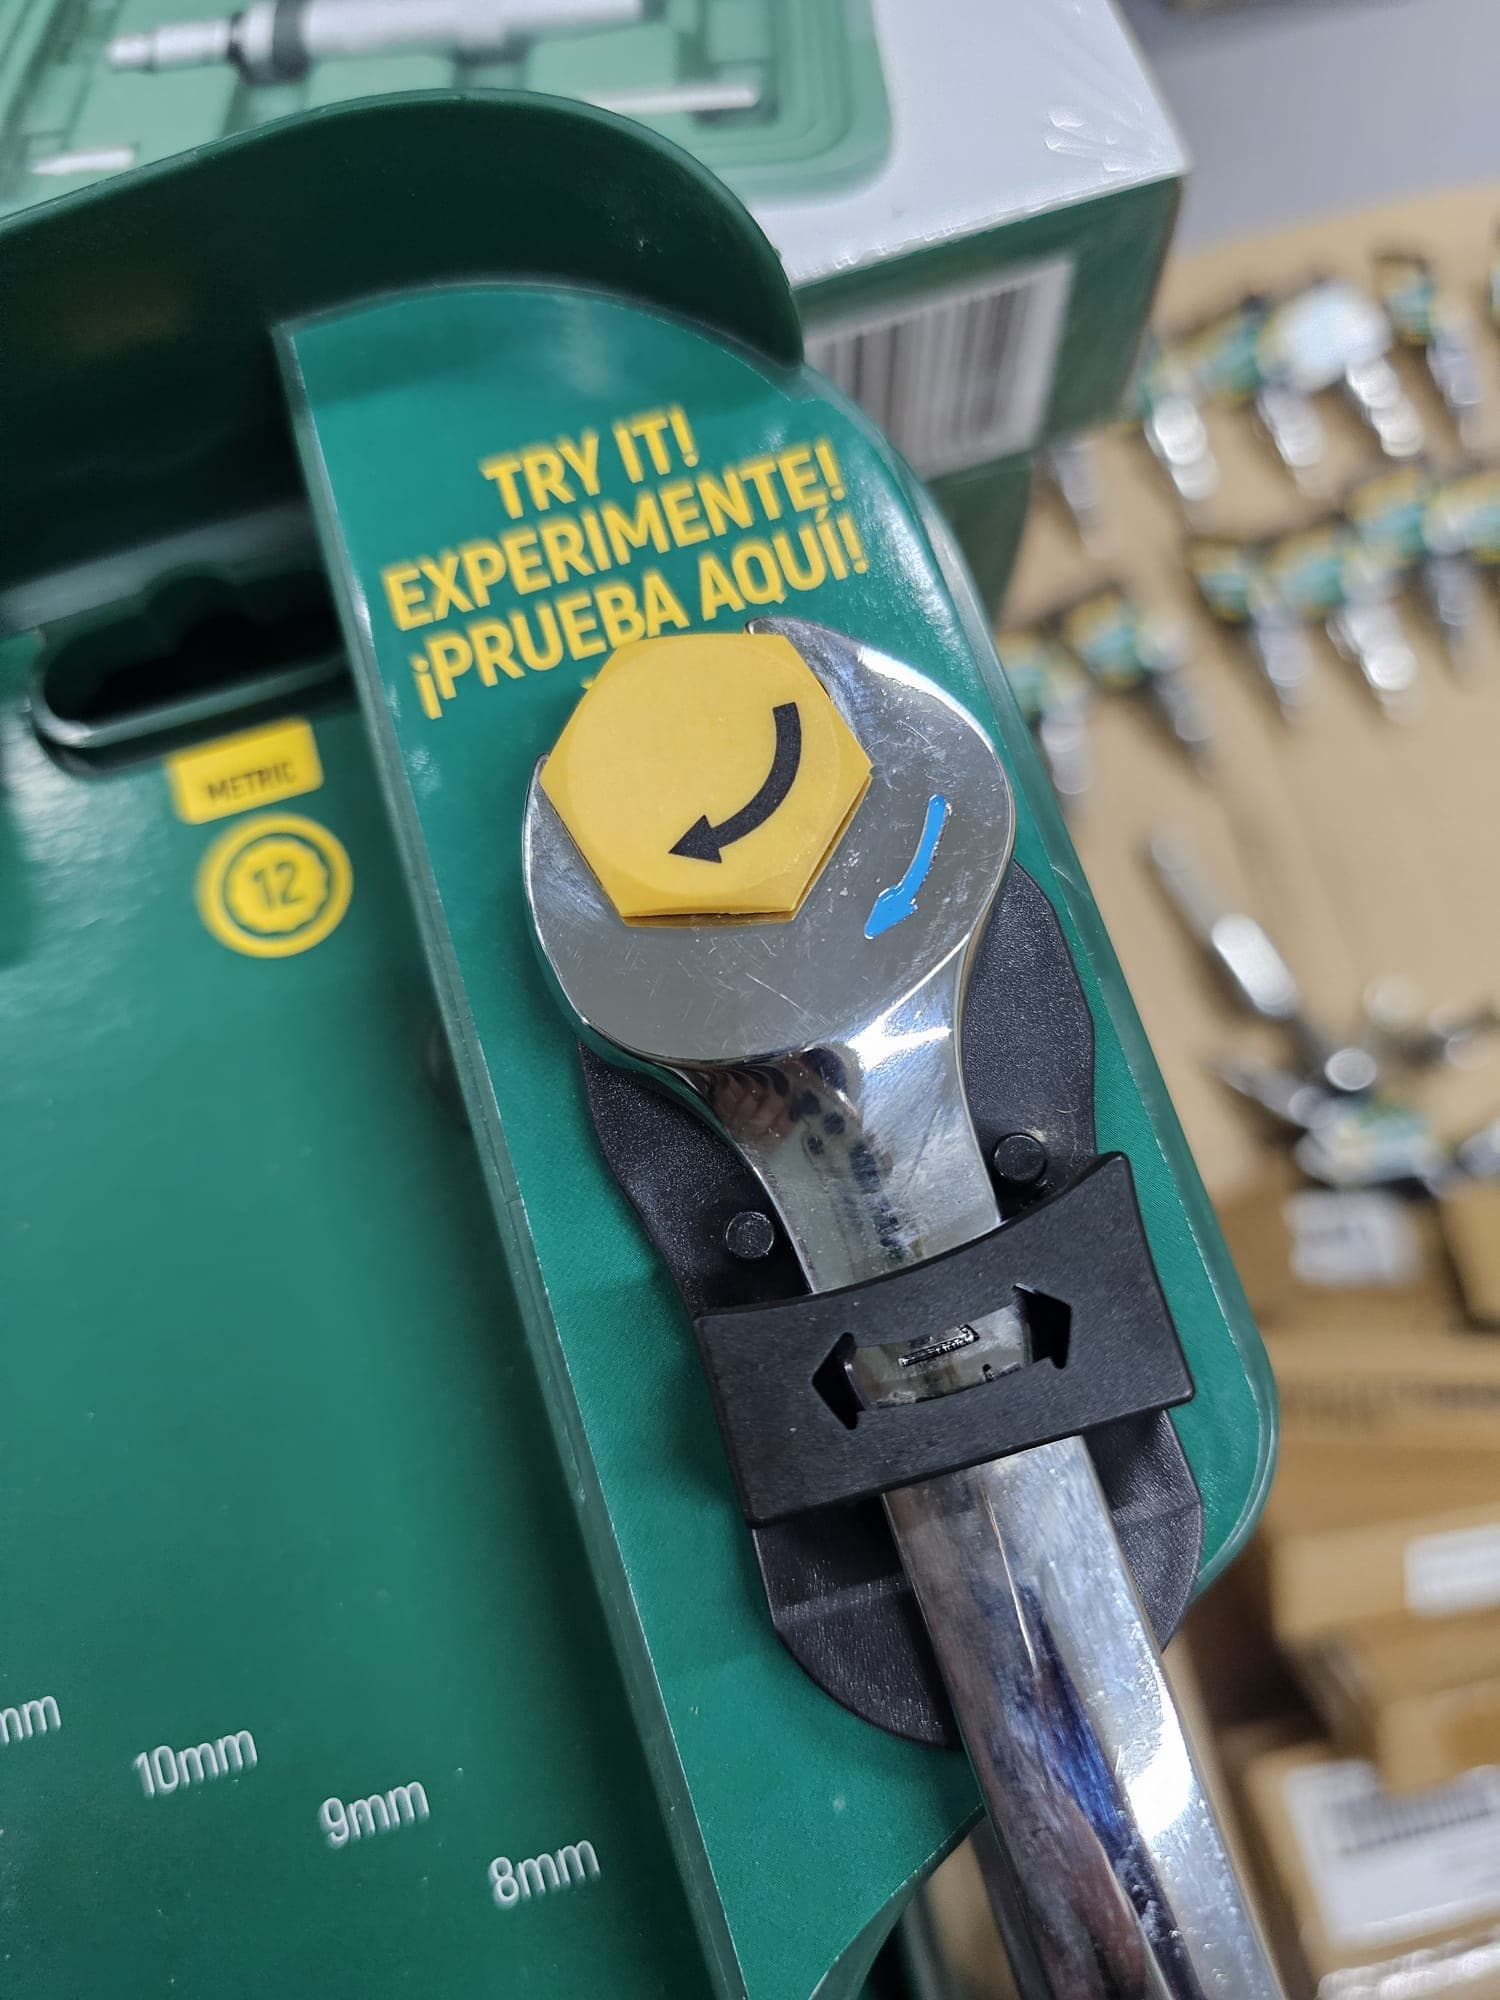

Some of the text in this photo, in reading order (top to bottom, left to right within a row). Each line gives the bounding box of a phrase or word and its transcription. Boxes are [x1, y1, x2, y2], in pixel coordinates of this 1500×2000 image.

[480, 405, 698, 519] TRY IT!
[382, 437, 846, 631] EXPERIMENTE!
[411, 506, 869, 719] ¡PRUEBA AQUÍ!
[205, 762, 297, 801] METRIC
[251, 861, 305, 911] 12
[134, 1729, 258, 1797] 10mm
[319, 1781, 430, 1849] 9mm
[488, 1839, 600, 1908] 8mm
